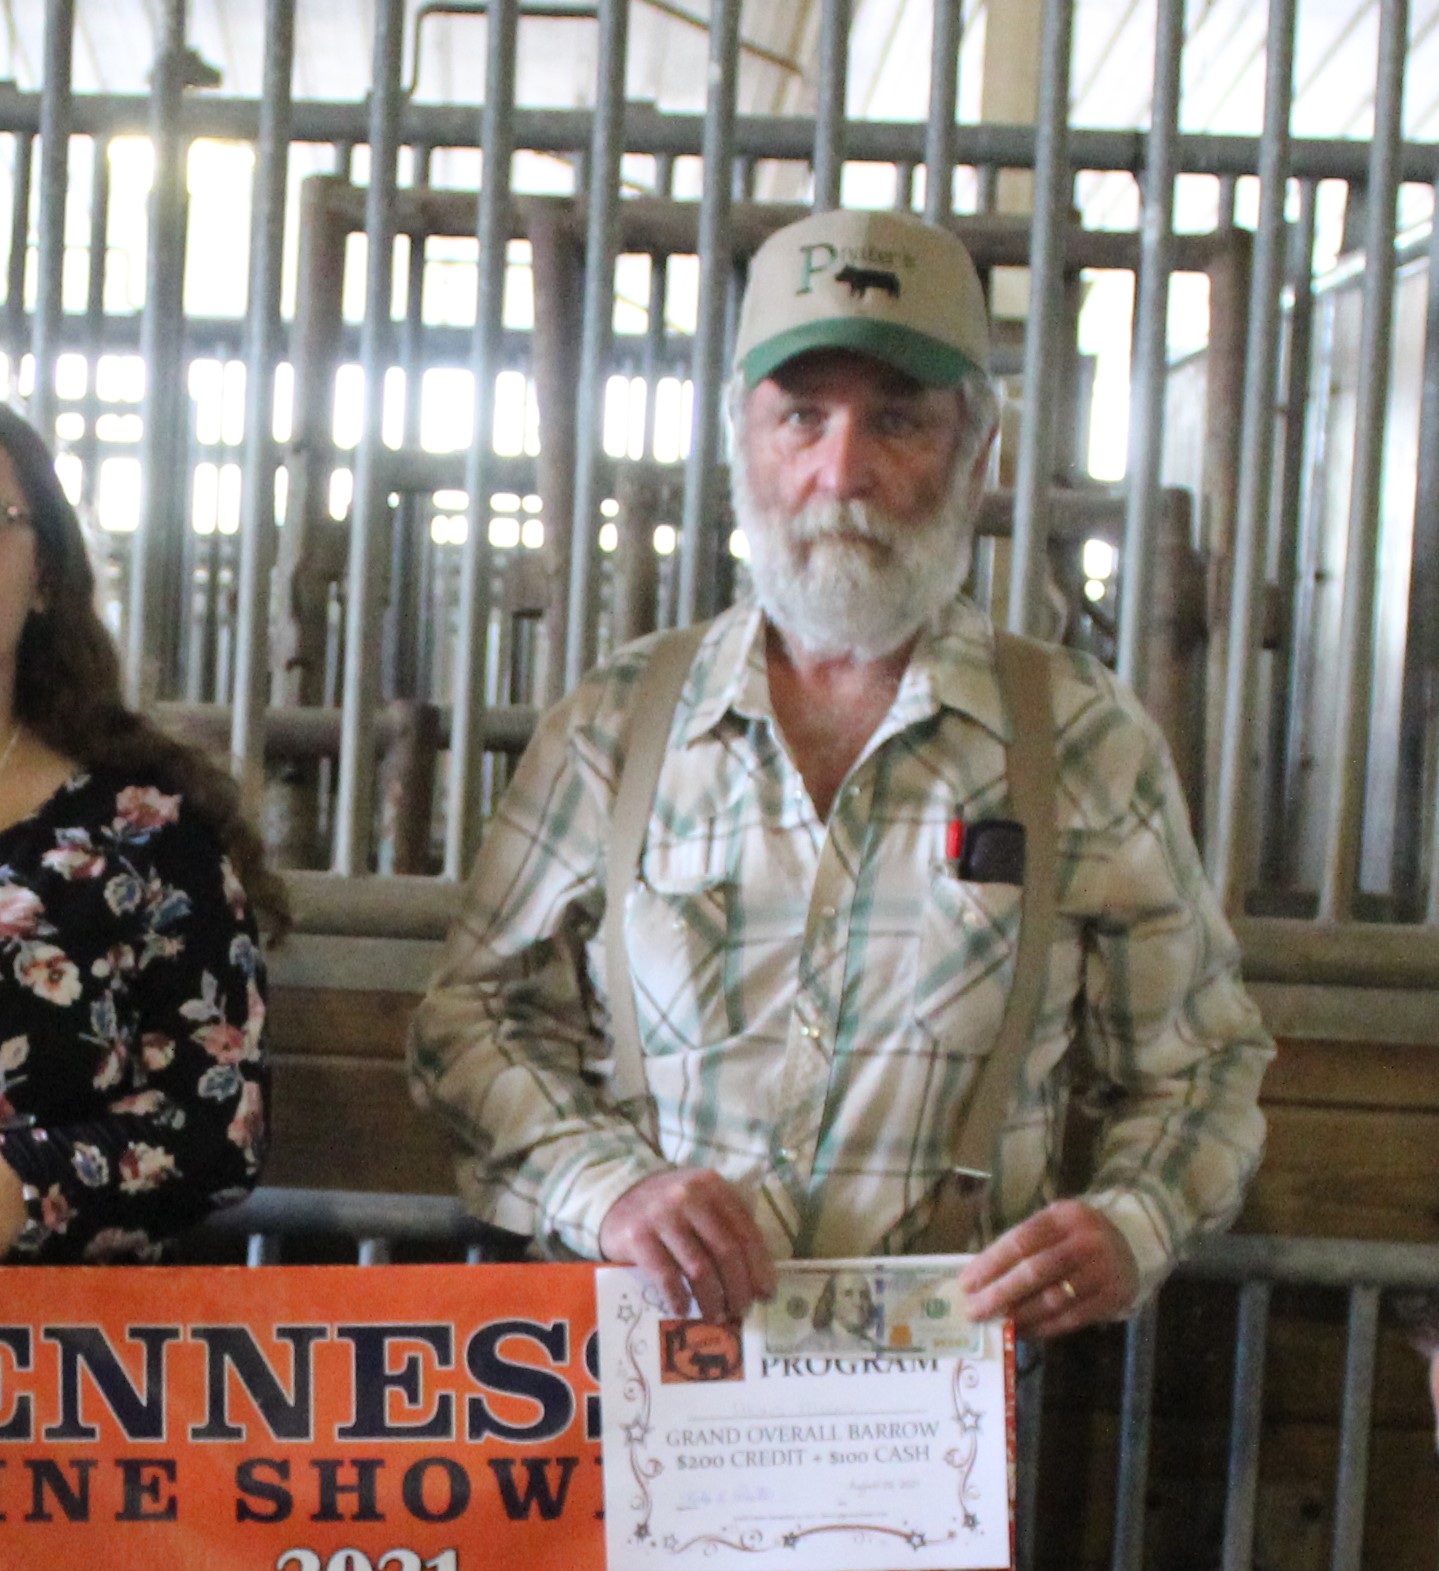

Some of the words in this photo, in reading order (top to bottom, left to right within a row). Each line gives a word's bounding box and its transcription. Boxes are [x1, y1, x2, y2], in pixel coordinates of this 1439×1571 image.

[666, 1427, 741, 1447] GRAND
[747, 1424, 841, 1444] OVERALL
[847, 1420, 940, 1441] BARROW
[677, 1454, 724, 1470] $200
[730, 1449, 805, 1468] CREDIT
[829, 1450, 869, 1465] $100
[874, 1444, 930, 1463] CASH
[235, 1455, 604, 1523] SHOW
